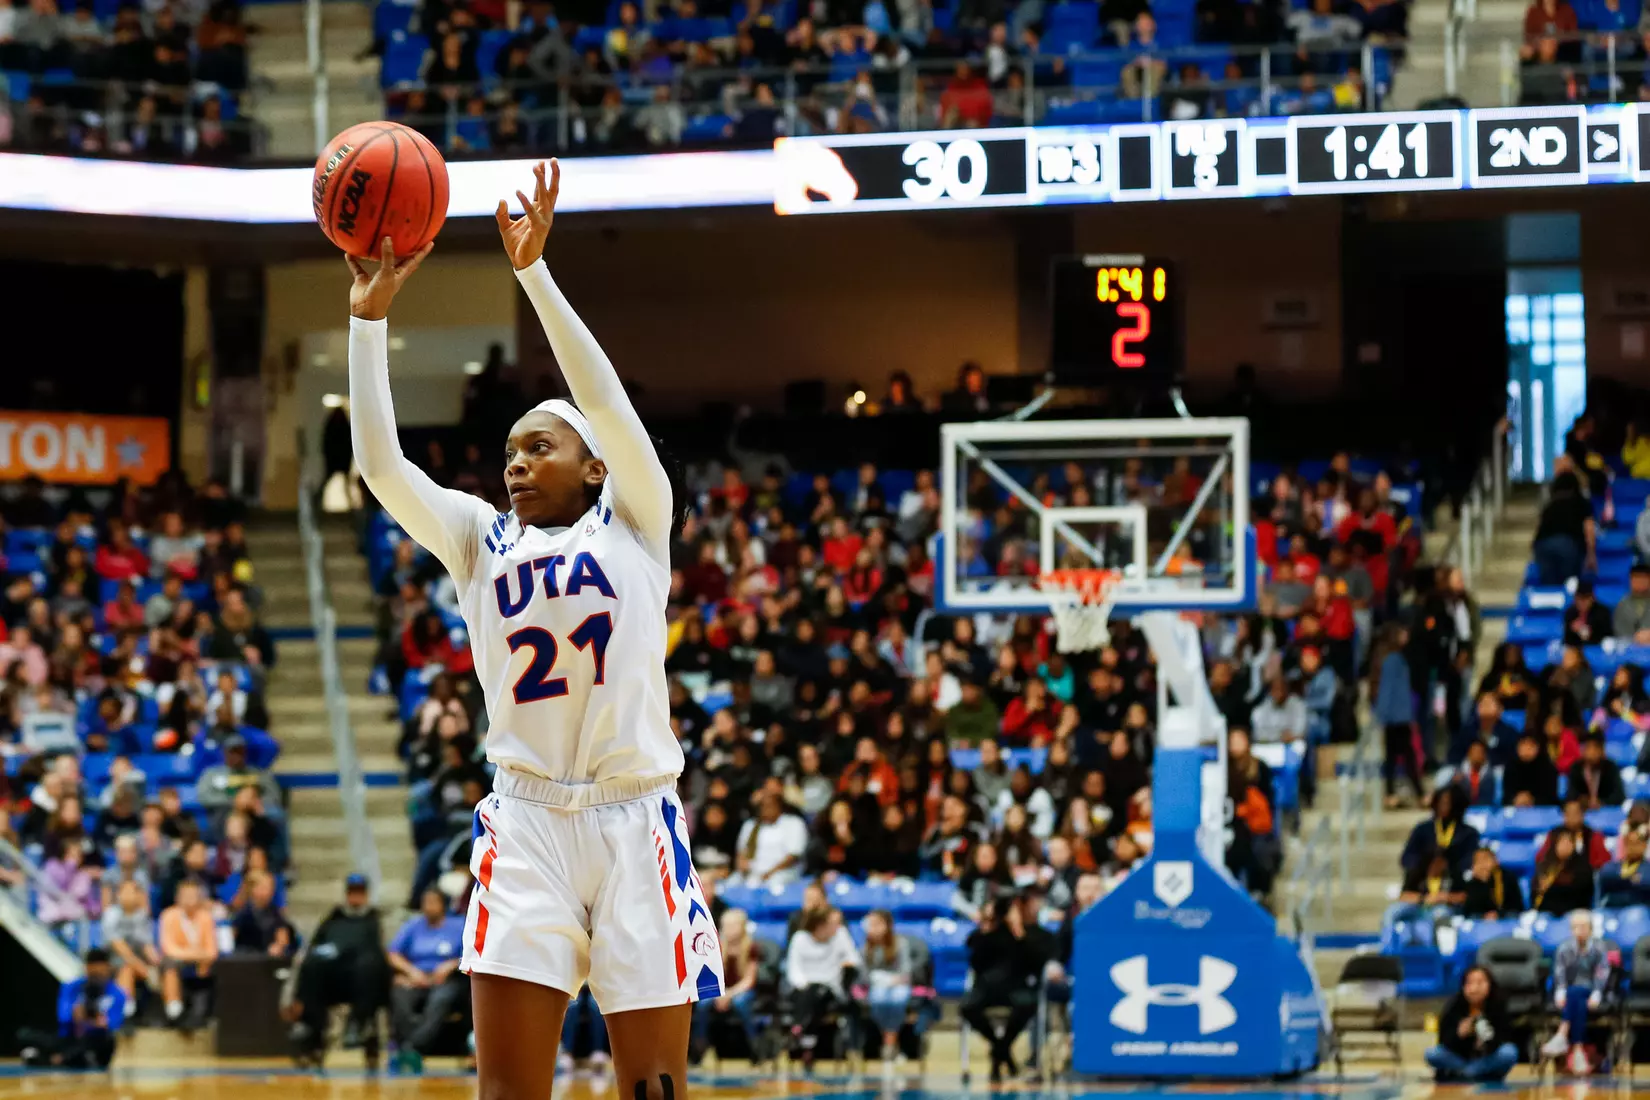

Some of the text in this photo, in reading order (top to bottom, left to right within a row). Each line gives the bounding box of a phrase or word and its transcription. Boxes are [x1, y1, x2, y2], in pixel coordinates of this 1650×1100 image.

[902, 138, 988, 202] 30
[1324, 122, 1429, 181] 1:41
[1489, 125, 1567, 168] 2ND
[337, 168, 372, 237] NCAA
[1097, 267, 1166, 302] 1:41
[1112, 302, 1151, 368] 2
[493, 551, 618, 619] UTA
[506, 611, 614, 705] 21
